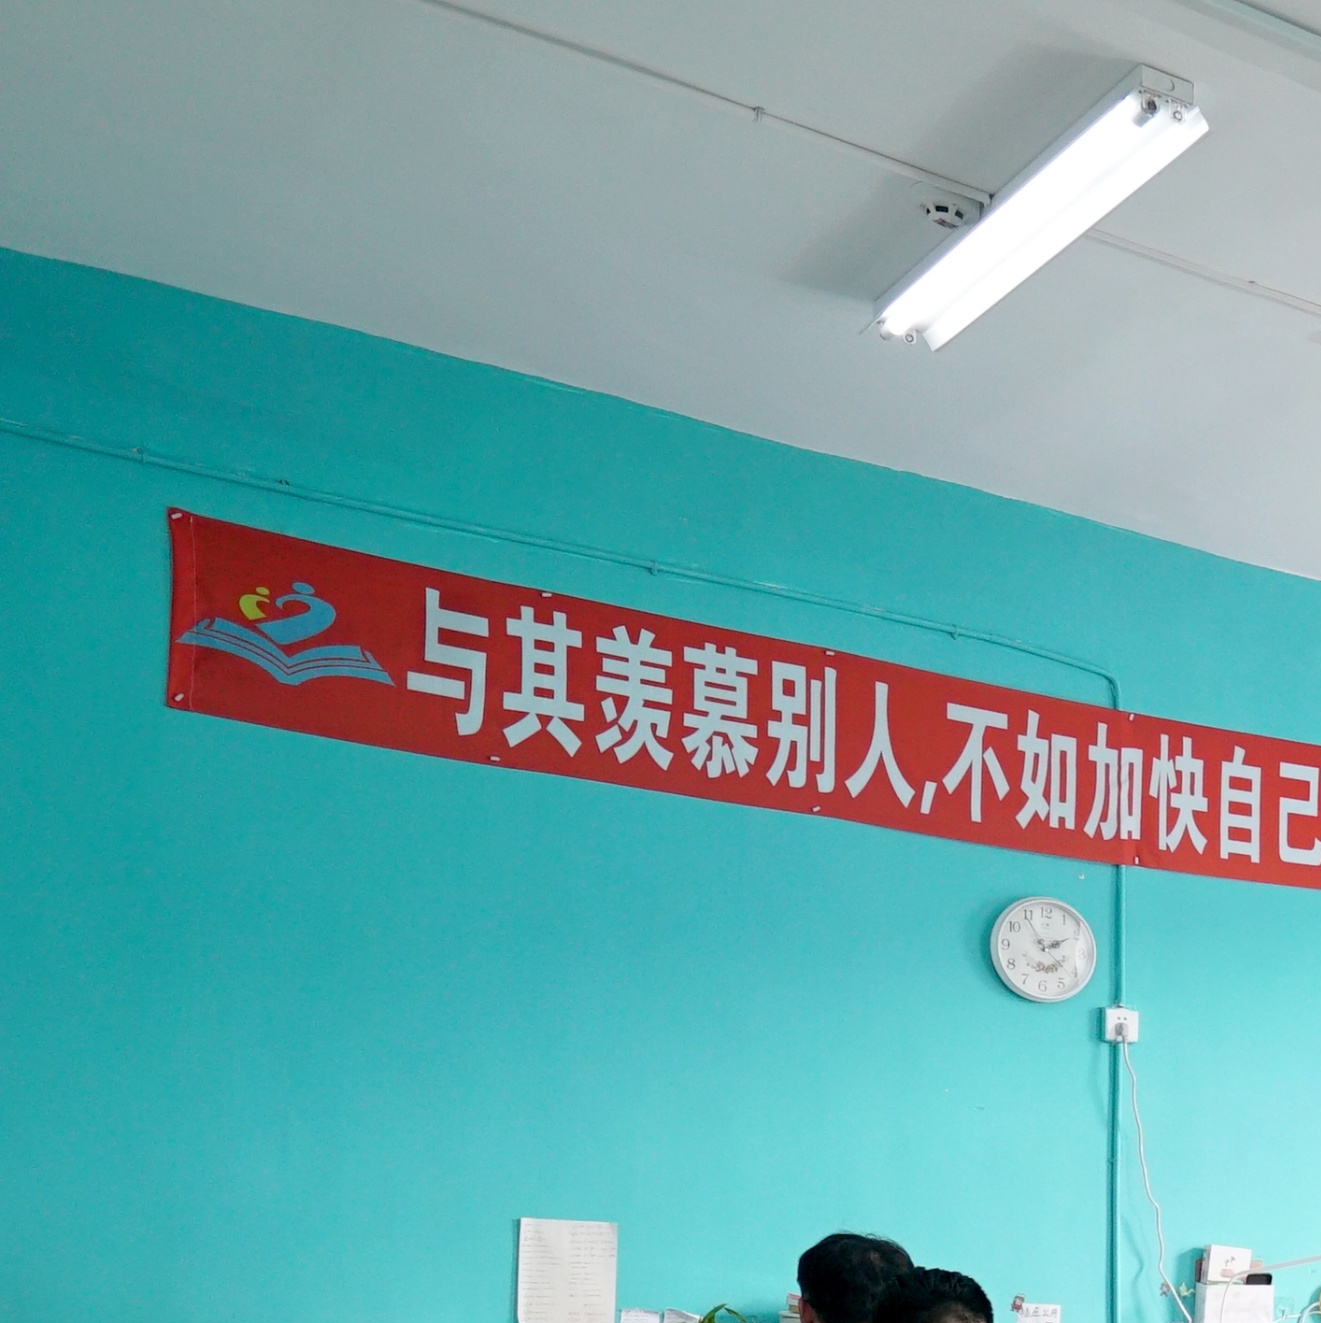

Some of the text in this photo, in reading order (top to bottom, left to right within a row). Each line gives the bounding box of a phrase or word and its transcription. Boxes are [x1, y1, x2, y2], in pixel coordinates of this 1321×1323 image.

[1040, 907, 1053, 919] 12
[1061, 914, 1067, 925] 1
[1008, 920, 1021, 933] 10
[1001, 939, 1010, 950] 9
[1006, 959, 1016, 970] 8
[1021, 973, 1030, 985] 7
[1057, 978, 1065, 989] 5
[1038, 980, 1047, 992] 6
